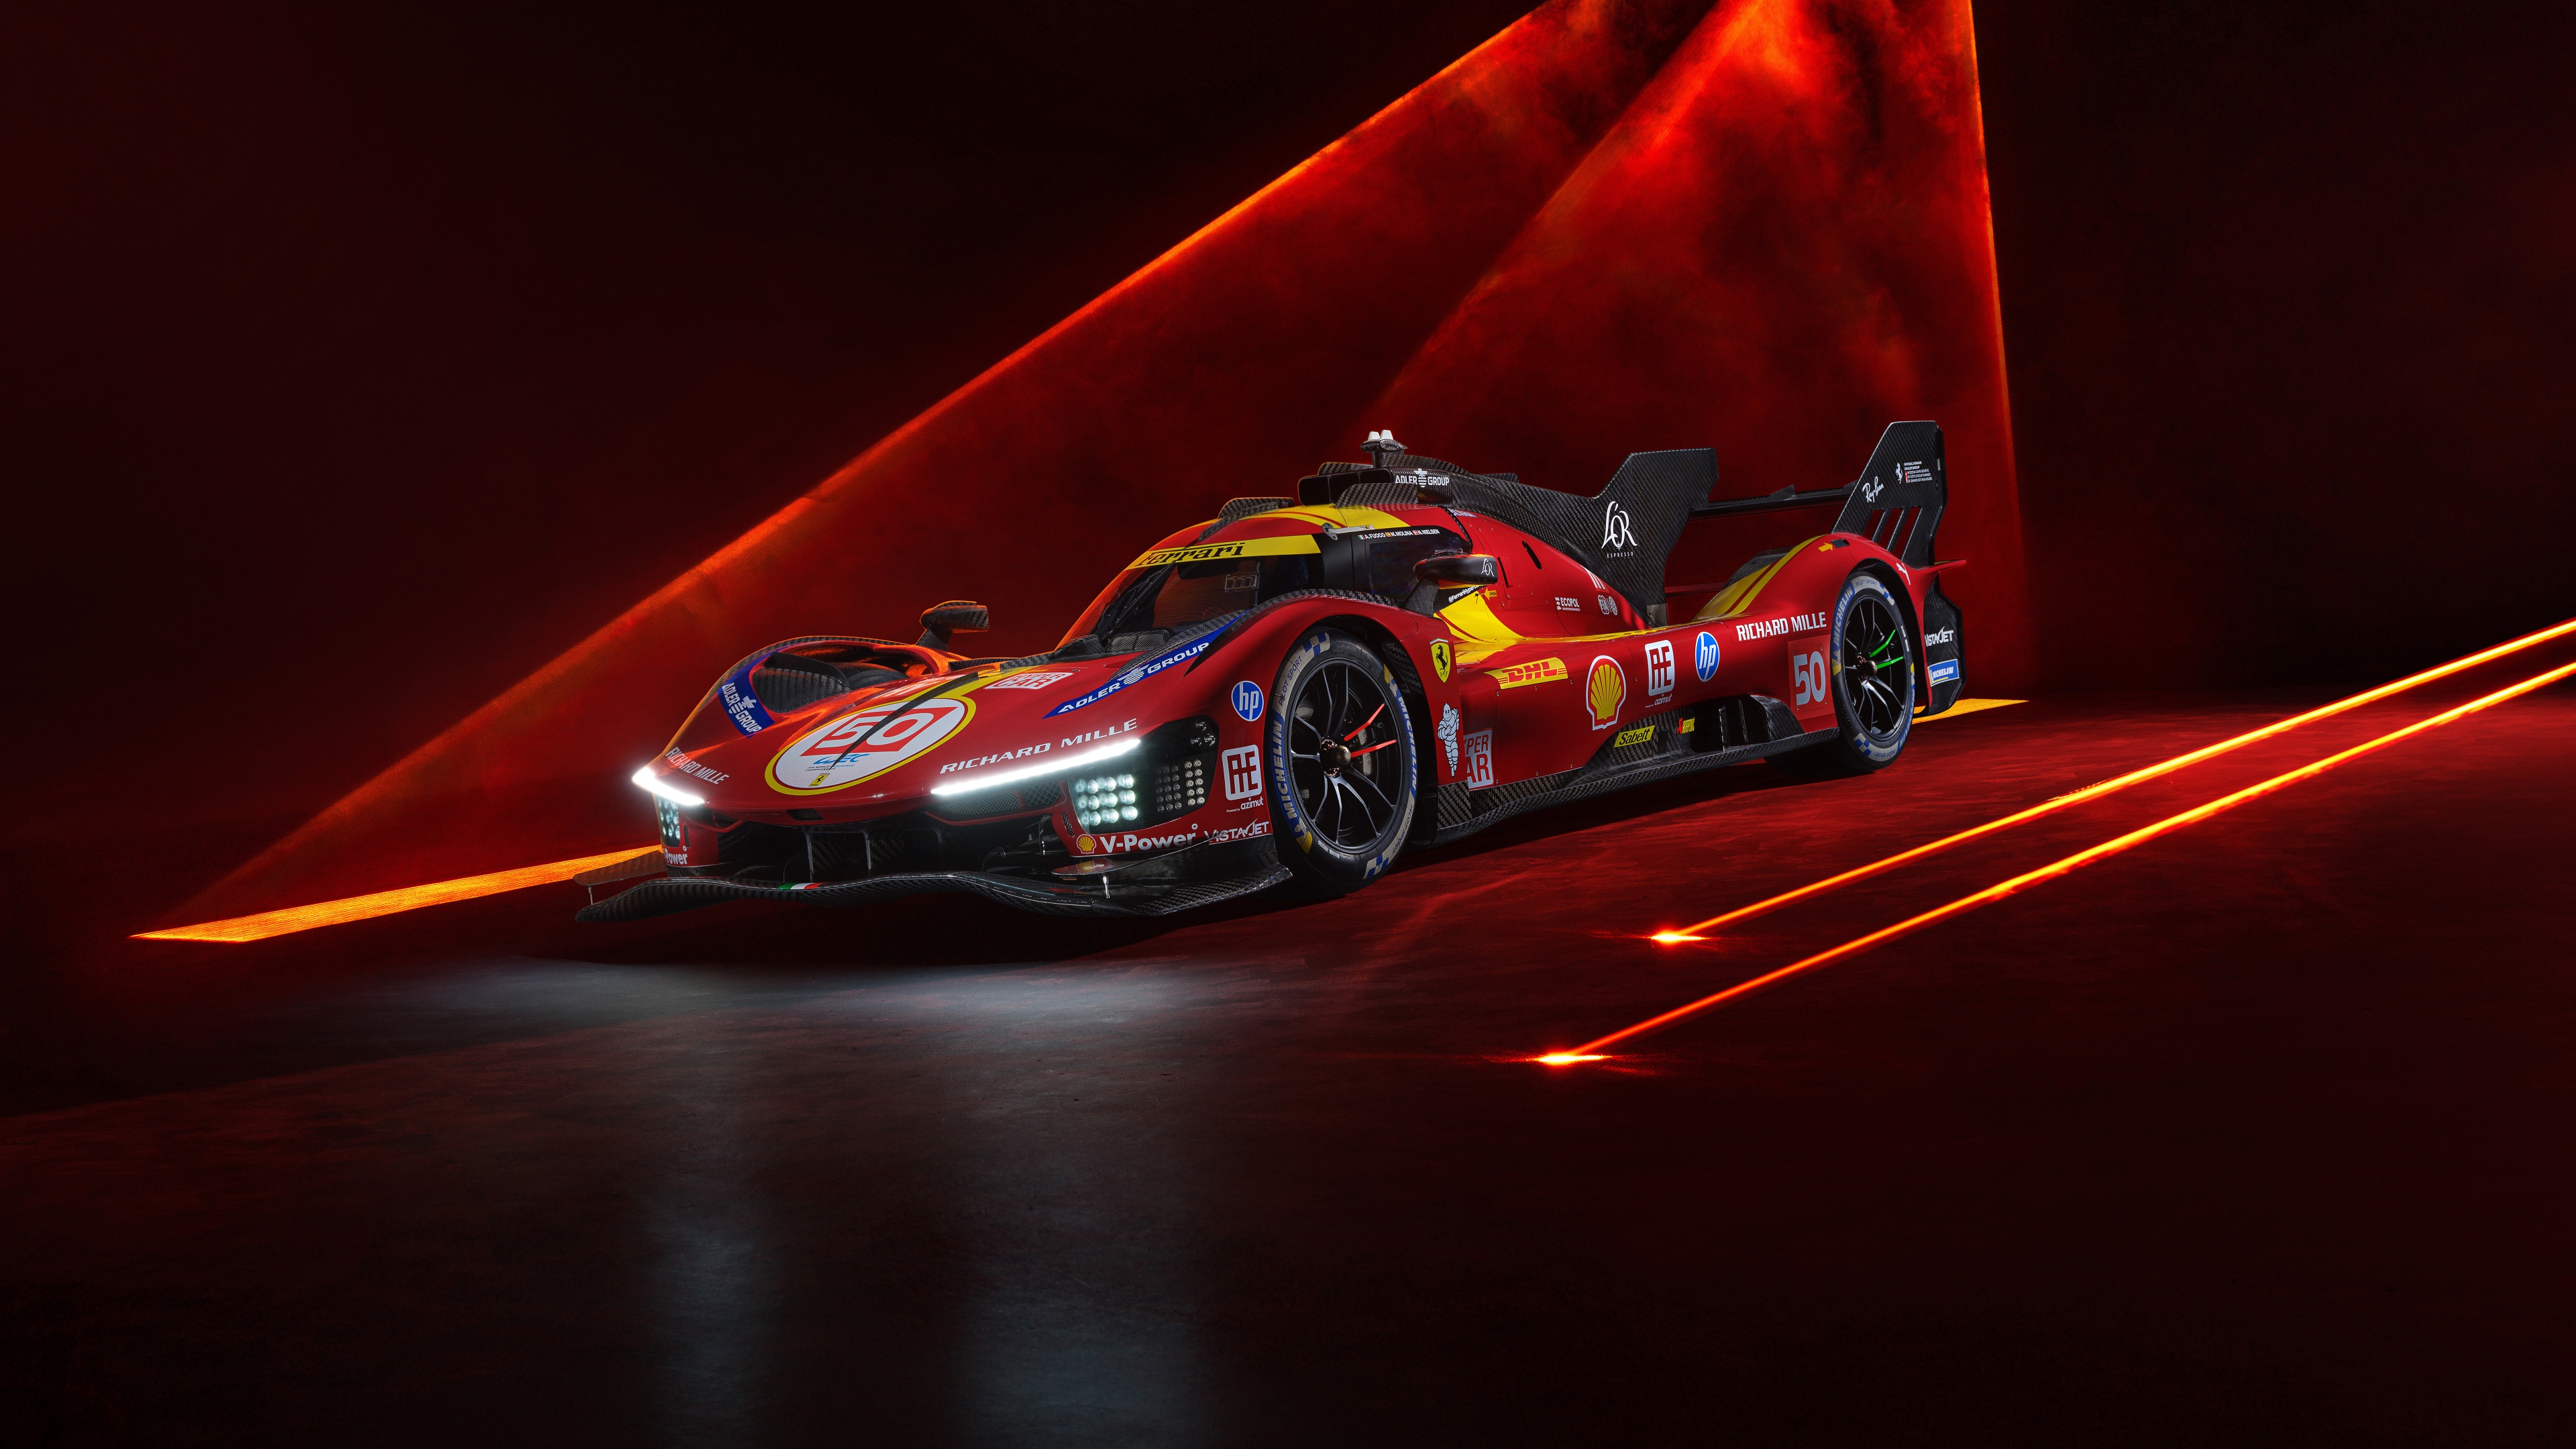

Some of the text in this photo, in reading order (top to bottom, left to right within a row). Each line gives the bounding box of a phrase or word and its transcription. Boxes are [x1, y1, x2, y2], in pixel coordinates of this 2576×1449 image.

[1395, 476, 1450, 486] ADLER GROUP
[1862, 476, 1884, 502] Ray-Ban
[1134, 542, 1246, 567] Ferrari
[1856, 579, 1865, 587] PILOT
[1560, 597, 1580, 608] ECOPOL
[1833, 586, 1854, 647] MICHELIN
[1735, 611, 1827, 641] RICHARD MILLE
[1501, 661, 1557, 682] DHL
[1699, 632, 1717, 681] hp
[993, 678, 1052, 688] CAR
[1058, 642, 1210, 713] ADLER GROUP
[1279, 655, 1303, 706] PILOT SPORT
[1793, 651, 1826, 706] 50
[1933, 667, 1953, 679] MICHELIN
[722, 682, 762, 733] ADLER GROUP
[1239, 682, 1259, 720] hp
[1654, 693, 1672, 706] azimut
[814, 712, 934, 749] 50
[1398, 696, 1417, 791] MICHELIN
[1464, 735, 1489, 755] PER
[1619, 729, 1650, 745] Sabelt
[940, 718, 1138, 774] RICHARD MILLE
[665, 746, 730, 785] RICHARD MILLE
[1273, 719, 1298, 820] MICHELIN
[1466, 753, 1491, 784] AR
[1241, 796, 1264, 810] azimut
[1099, 832, 1197, 853] V-Power
